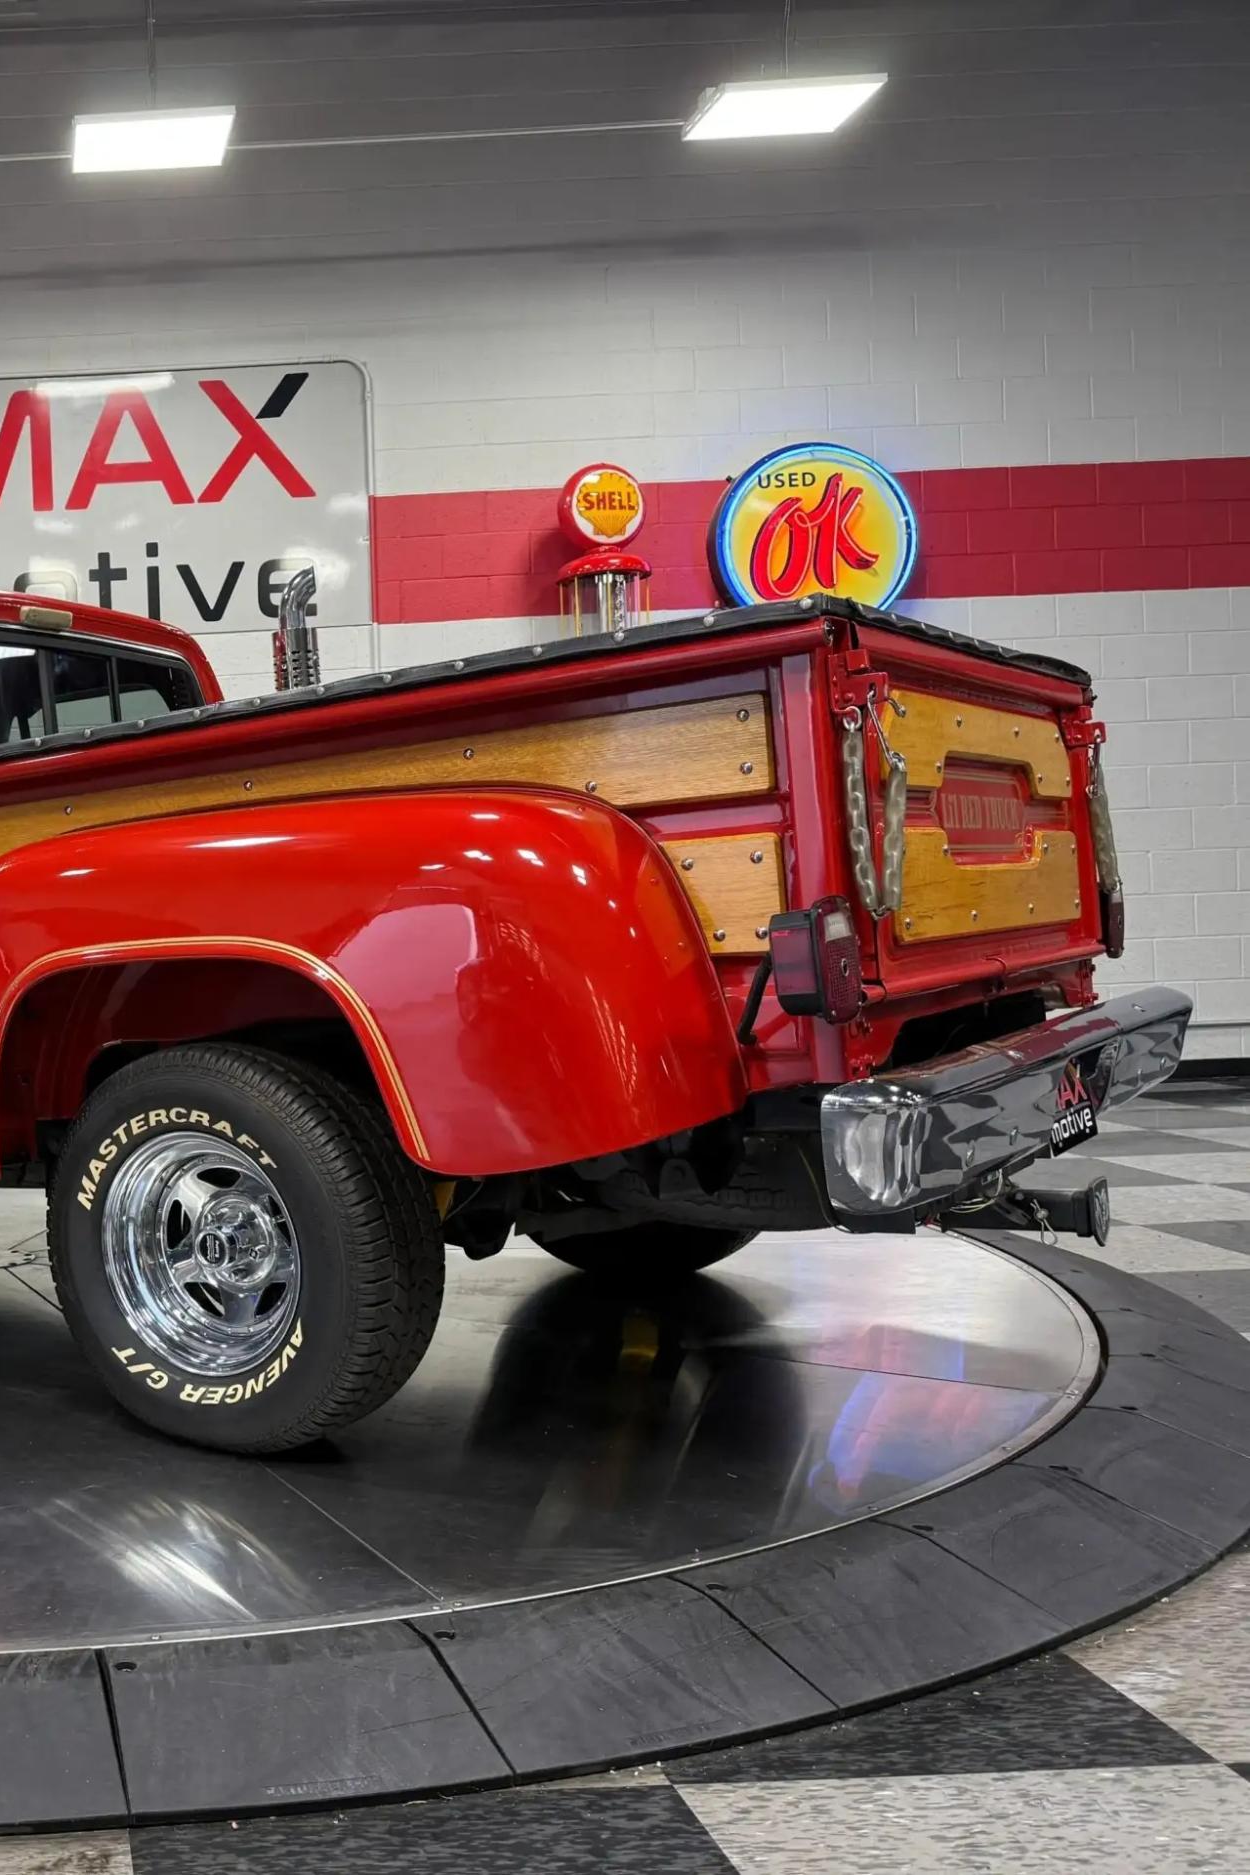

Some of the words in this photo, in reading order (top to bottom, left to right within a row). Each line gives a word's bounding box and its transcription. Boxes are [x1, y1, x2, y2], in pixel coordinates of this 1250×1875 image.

[582, 489, 636, 512] SHELL
[757, 471, 817, 490] USED
[750, 473, 880, 600] OK
[1051, 1107, 1093, 1144] motive
[76, 1106, 278, 1211] MASTERCRAFT
[111, 1344, 170, 1391] G/T
[179, 1317, 304, 1405] AVENGER
